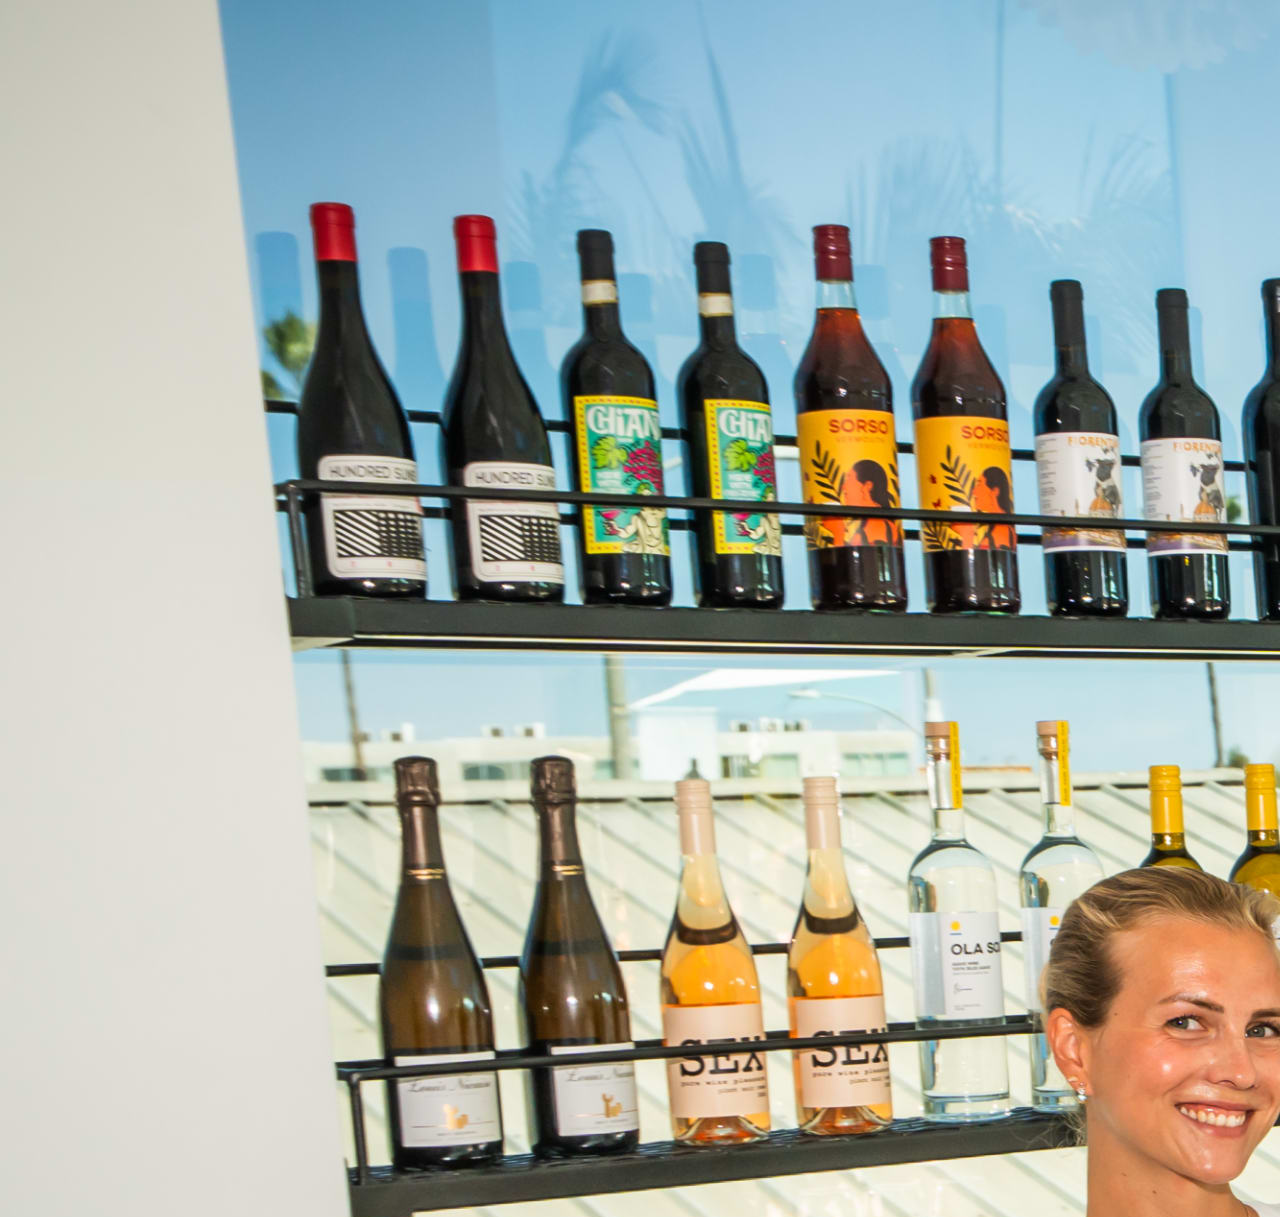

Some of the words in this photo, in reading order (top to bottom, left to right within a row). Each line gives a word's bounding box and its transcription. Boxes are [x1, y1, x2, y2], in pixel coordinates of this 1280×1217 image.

[828, 418, 889, 434] SORSO
[329, 466, 391, 479] HUNDRED
[475, 471, 534, 485] HUNDRED
[950, 943, 984, 956] OLA
